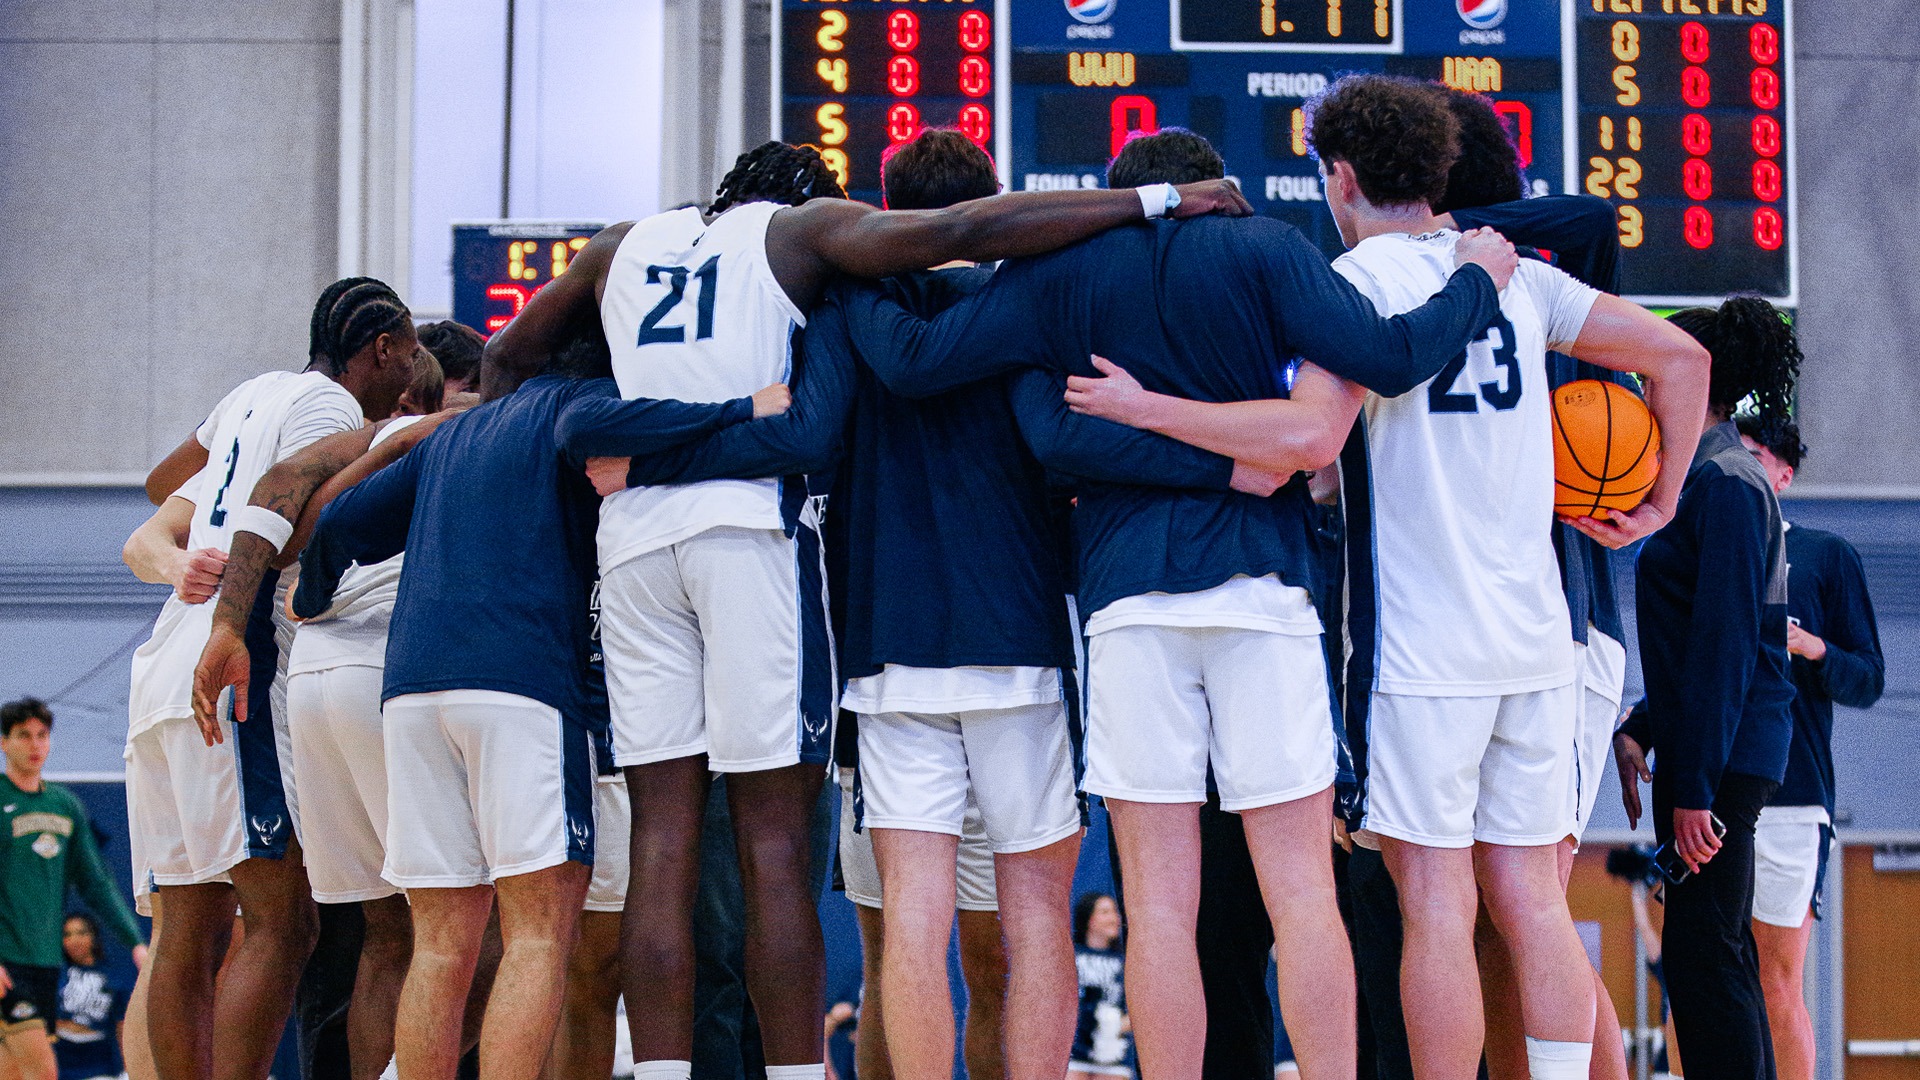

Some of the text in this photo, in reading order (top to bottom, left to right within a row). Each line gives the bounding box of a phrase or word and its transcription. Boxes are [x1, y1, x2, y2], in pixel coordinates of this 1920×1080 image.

[817, 9, 990, 52] 2 0 0
[1612, 20, 1778, 65] 0 0 0
[817, 55, 990, 98] 4 0 0
[1068, 52, 1136, 87] WWU
[1247, 72, 1328, 97] PERIOD
[1443, 56, 1501, 92] UAA
[1681, 66, 1711, 108] 0
[1751, 67, 1780, 110] 0
[887, 102, 920, 144] 0
[958, 103, 990, 144] 0
[1600, 113, 1781, 157] 11 0 0
[1586, 156, 1642, 199] 22
[1683, 158, 1712, 201] 0
[1752, 159, 1781, 202] 0
[1684, 205, 1713, 249] 0
[1753, 206, 1783, 250] 0
[636, 253, 723, 350] 21
[208, 434, 240, 528] 2
